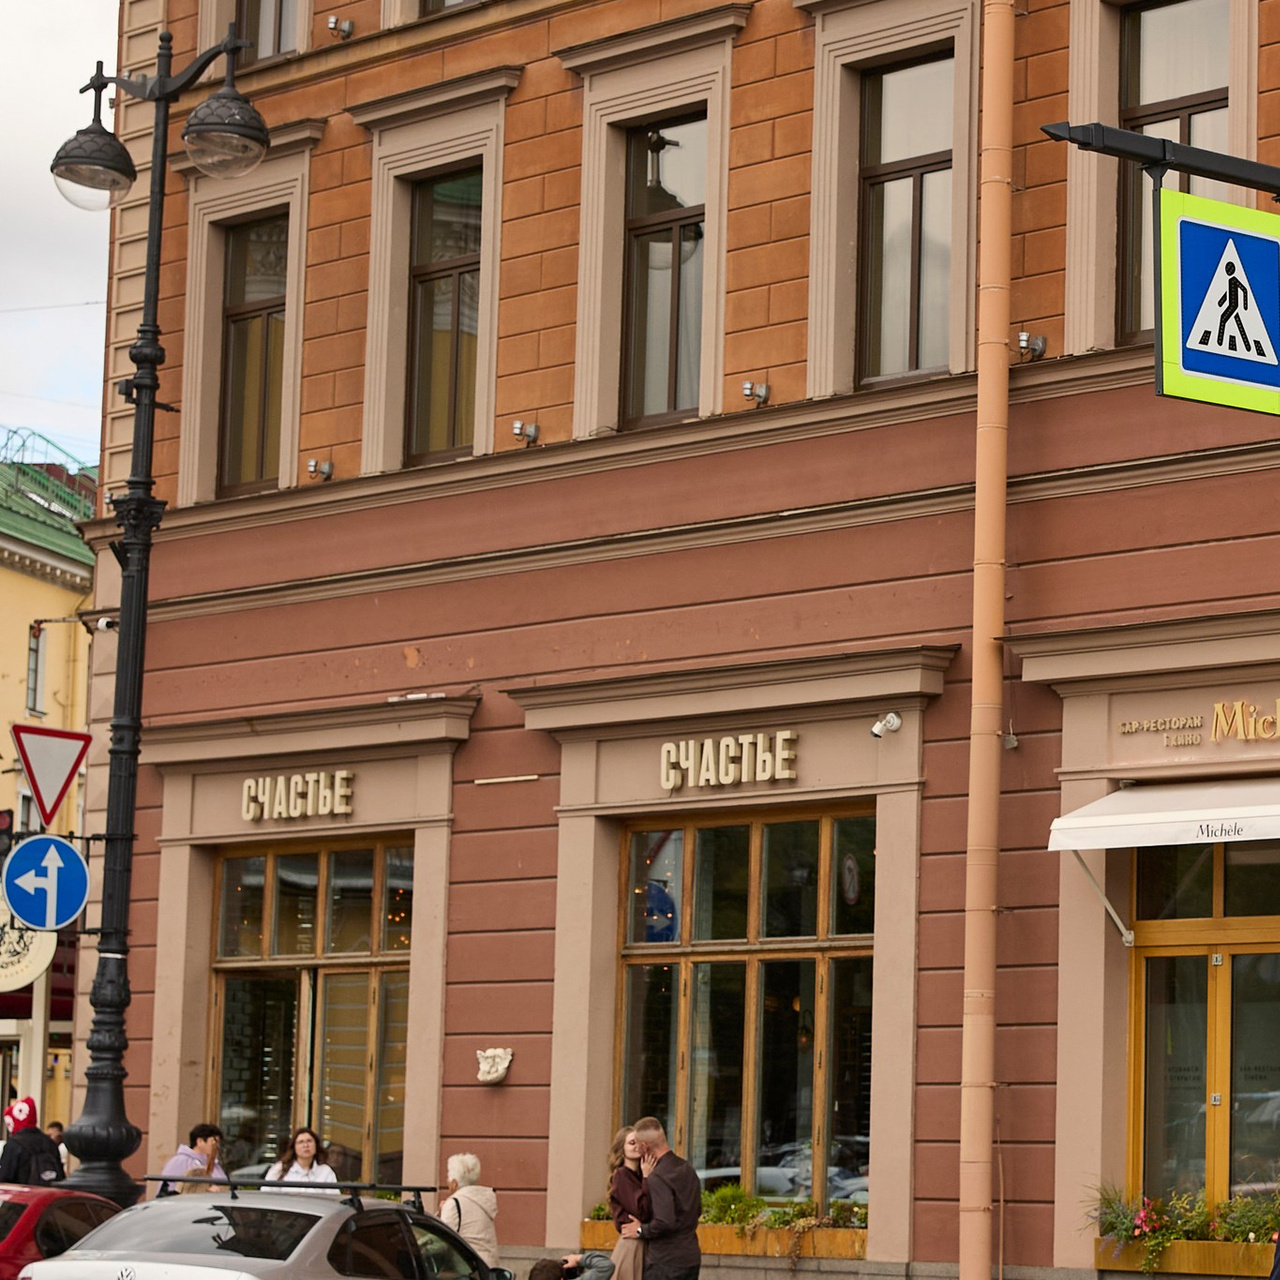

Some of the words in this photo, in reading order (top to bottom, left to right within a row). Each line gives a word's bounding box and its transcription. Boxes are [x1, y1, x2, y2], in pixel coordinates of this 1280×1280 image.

[661, 729, 798, 791] СЧАСТЬЕ
[242, 769, 355, 822] СЧАСТЬЕ
[1196, 822, 1244, 839] Michèle
